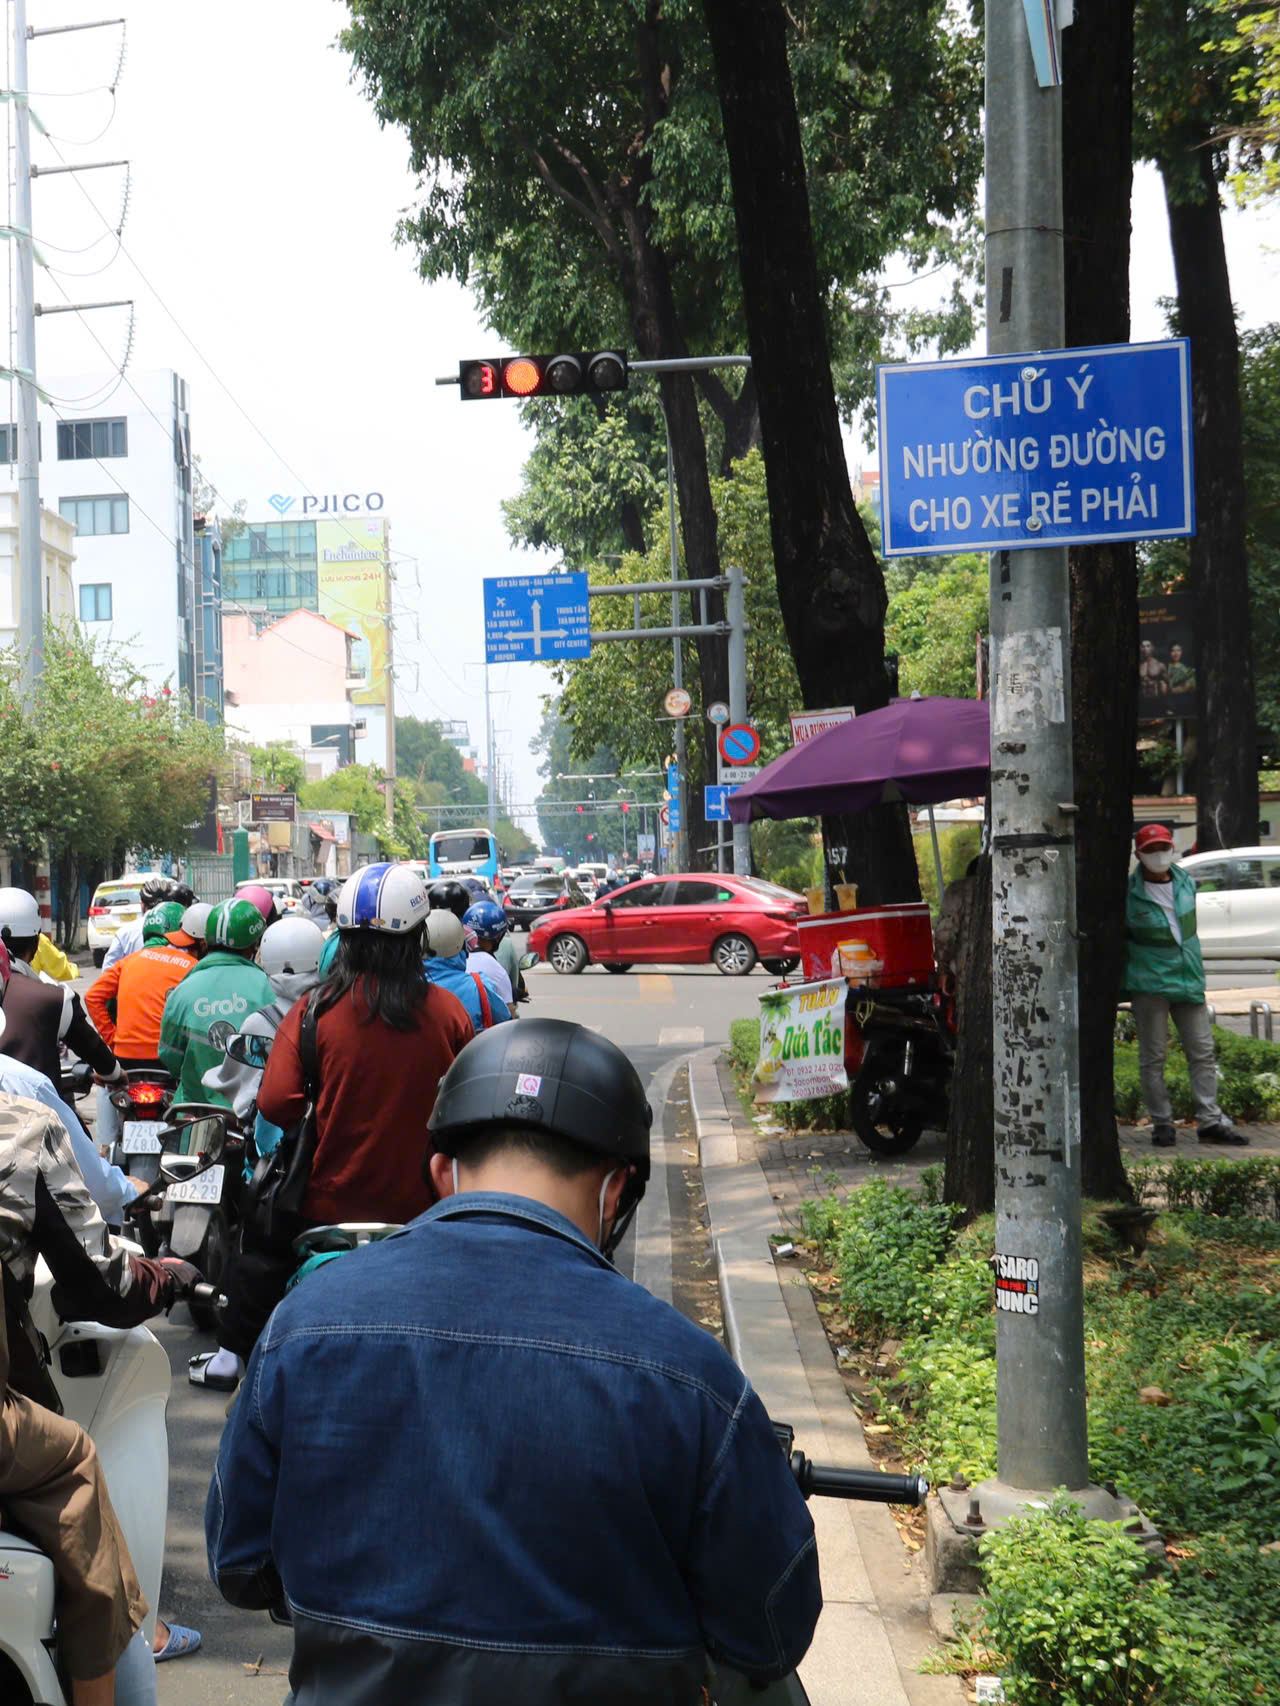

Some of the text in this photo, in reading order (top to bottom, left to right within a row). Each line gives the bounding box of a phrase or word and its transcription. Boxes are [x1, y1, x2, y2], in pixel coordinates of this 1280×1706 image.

[480, 366, 494, 393] 3
[1065, 363, 1095, 410] Ý
[903, 418, 1166, 480] NHƯỜNG ĐƯỜNG
[302, 492, 384, 514] PJICO
[908, 472, 1158, 534] CHO XE RẼ PHẢI
[827, 847, 848, 865] 157
[144, 911, 163, 926] rab
[140, 949, 191, 969] NEDERLAND
[193, 992, 248, 1017] Grab
